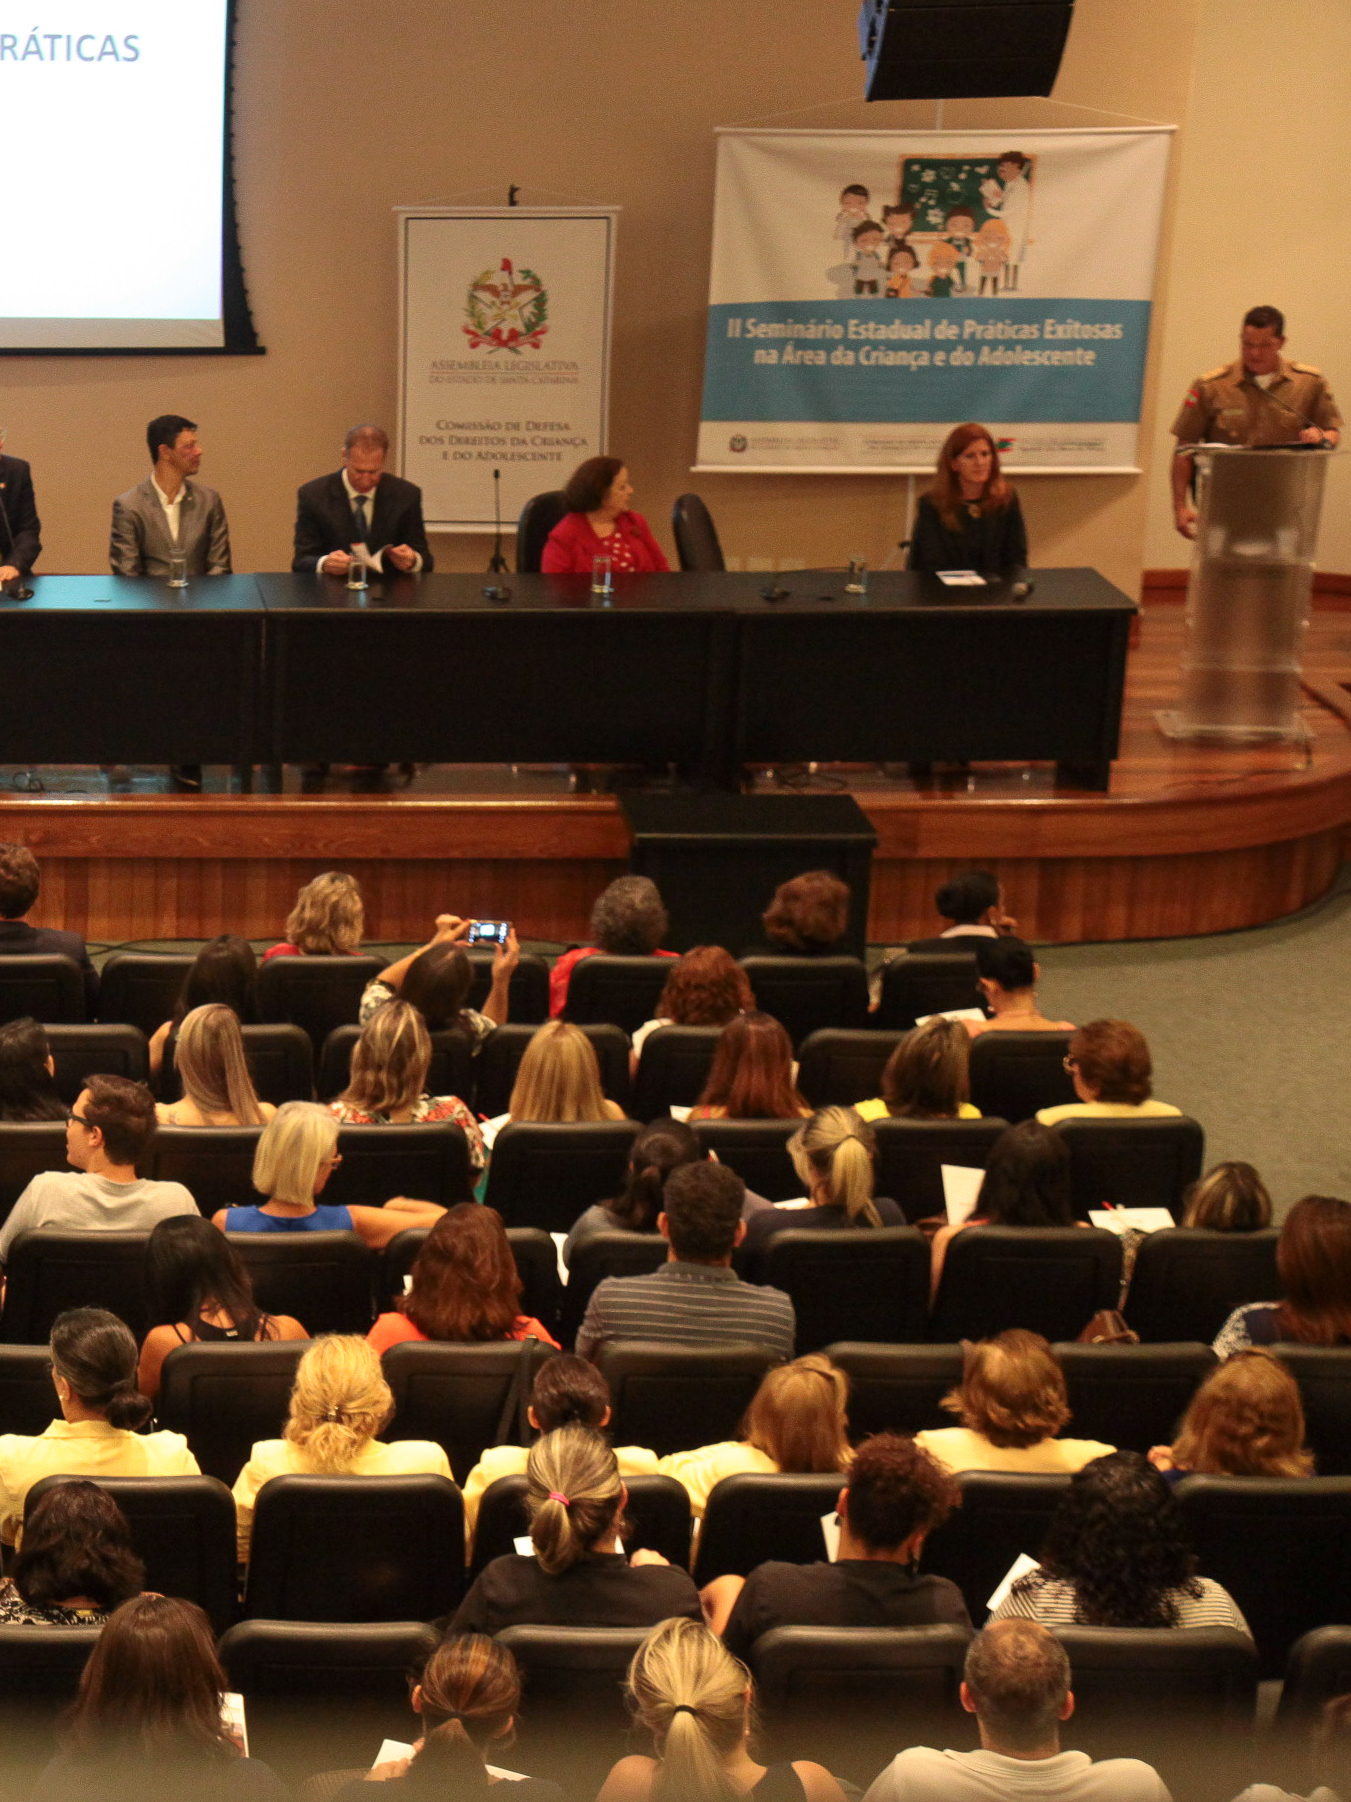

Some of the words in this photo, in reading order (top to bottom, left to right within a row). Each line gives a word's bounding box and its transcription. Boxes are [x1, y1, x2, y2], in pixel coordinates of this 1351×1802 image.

[745, 318, 844, 339] Seminário
[848, 318, 932, 339] Estadual
[934, 319, 960, 339] de
[963, 318, 1040, 339] Práticas
[1044, 318, 1124, 339] Exitosas
[754, 349, 779, 364] na
[781, 340, 827, 365] Área
[830, 344, 855, 365] da
[859, 345, 930, 371] Criança
[933, 350, 947, 366] e
[950, 345, 975, 366] do
[978, 345, 1096, 366] Adolescente
